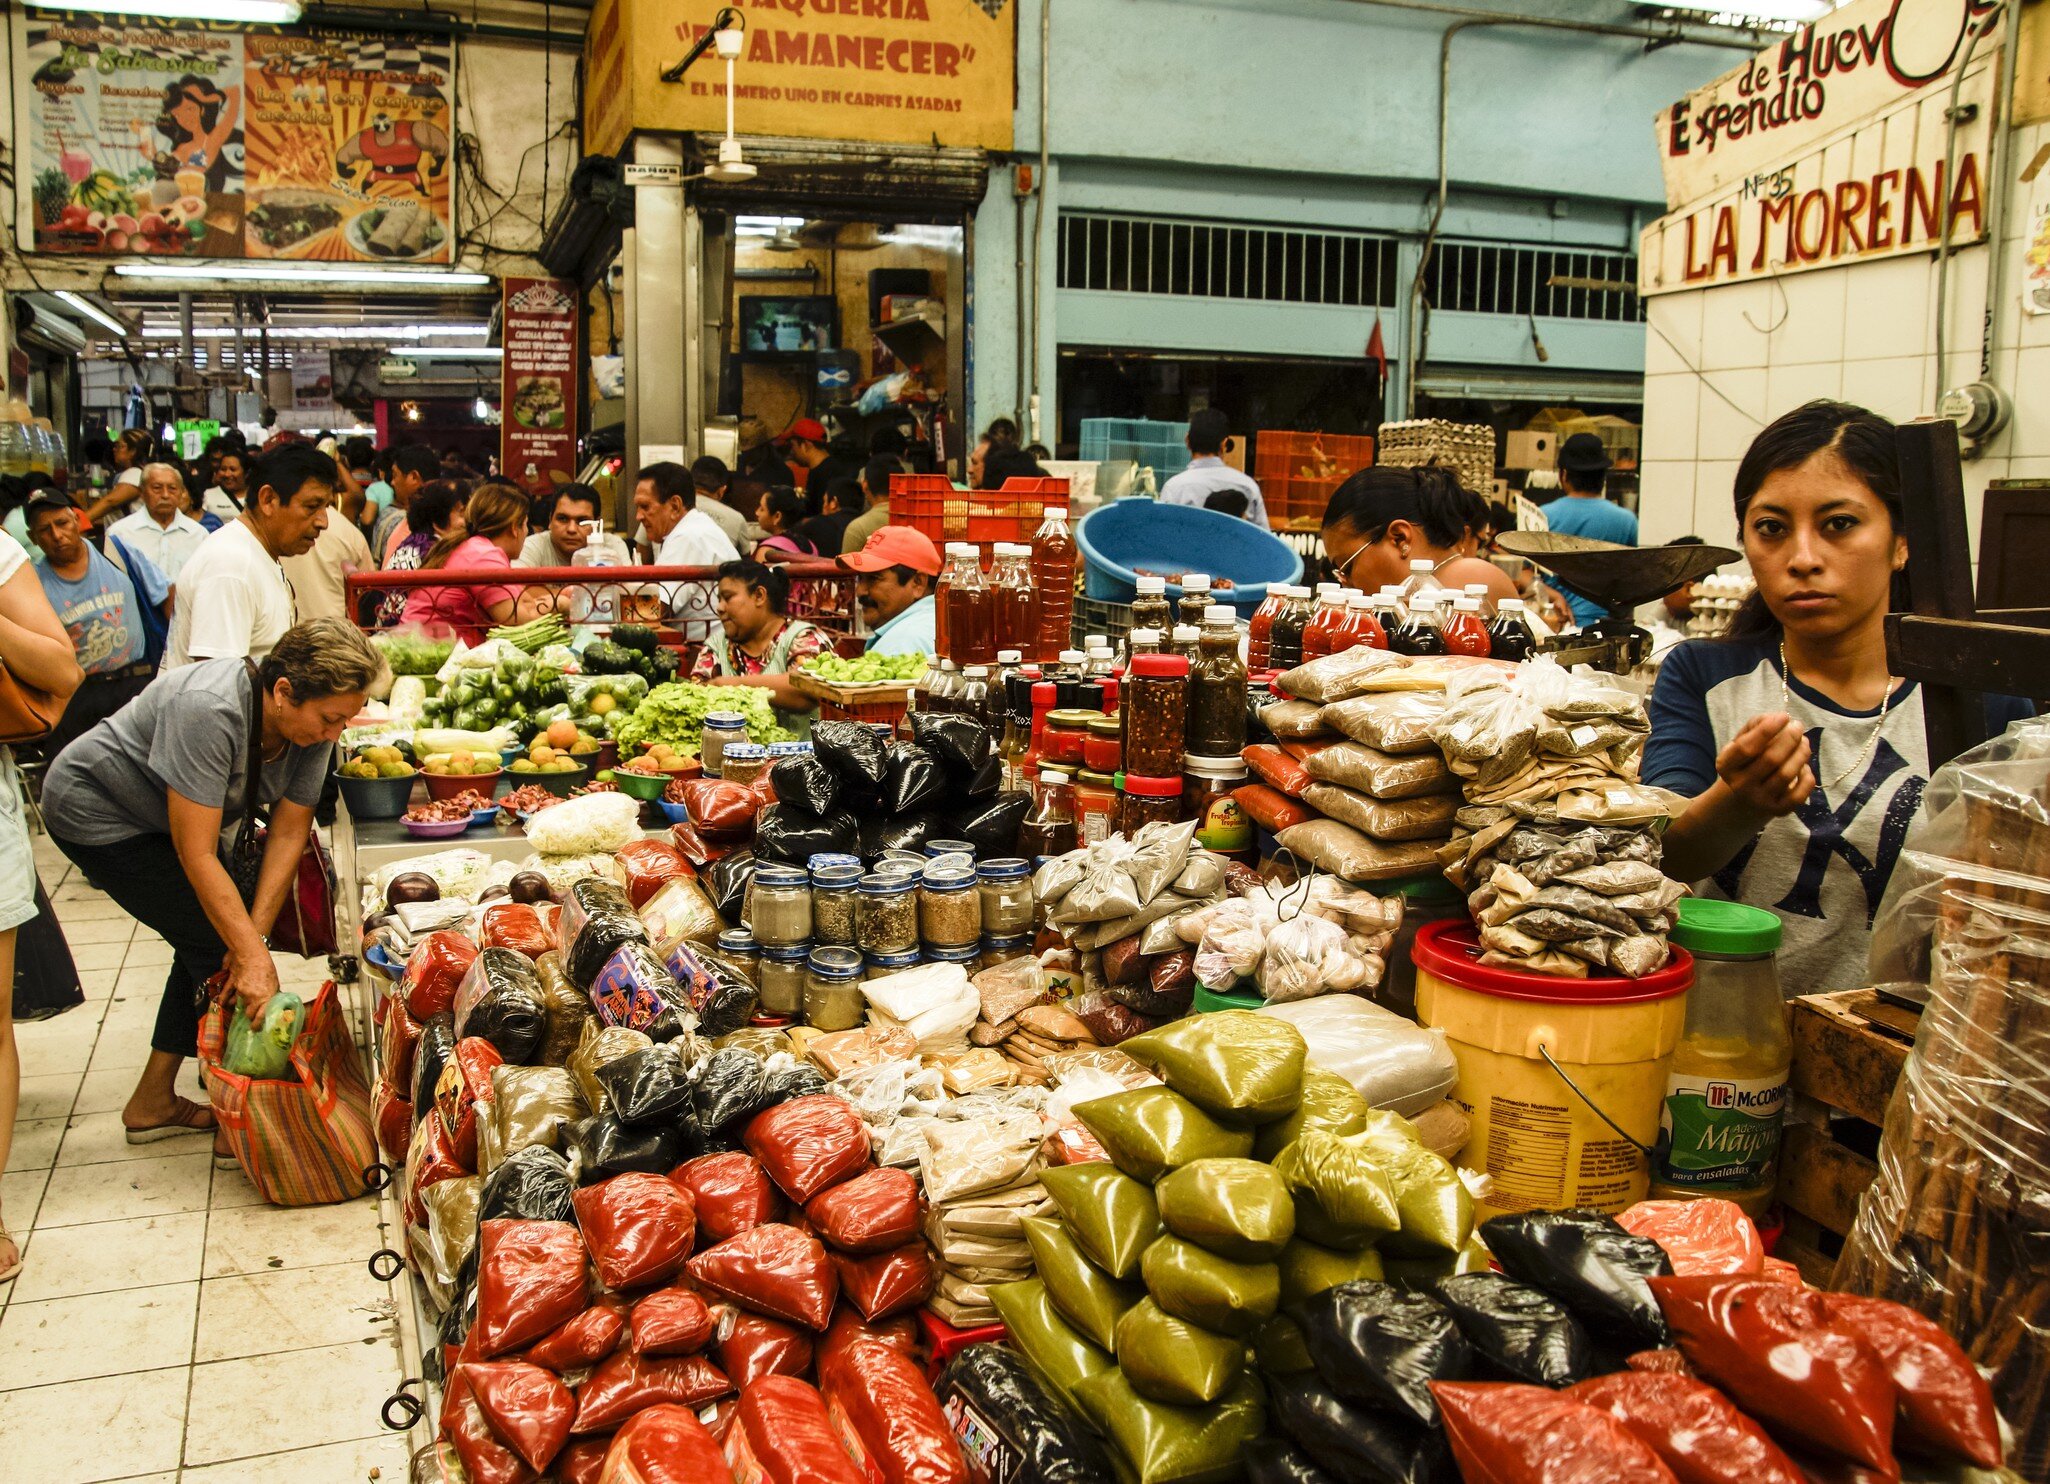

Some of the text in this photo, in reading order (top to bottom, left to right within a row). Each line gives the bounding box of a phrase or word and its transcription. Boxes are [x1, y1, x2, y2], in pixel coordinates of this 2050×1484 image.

[747, 29, 977, 78] AMANECER"
[1738, 58, 1770, 97] de
[691, 81, 708, 96] EL
[785, 87, 818, 103] UNO
[822, 89, 841, 104] EN
[845, 91, 902, 108] CARNES
[906, 94, 962, 112] ASADAS
[1686, 153, 1984, 280] LA MORENA
[1530, 1103, 1569, 1112] Nutrimental
[1672, 1165, 1750, 1181] para ensaladas
